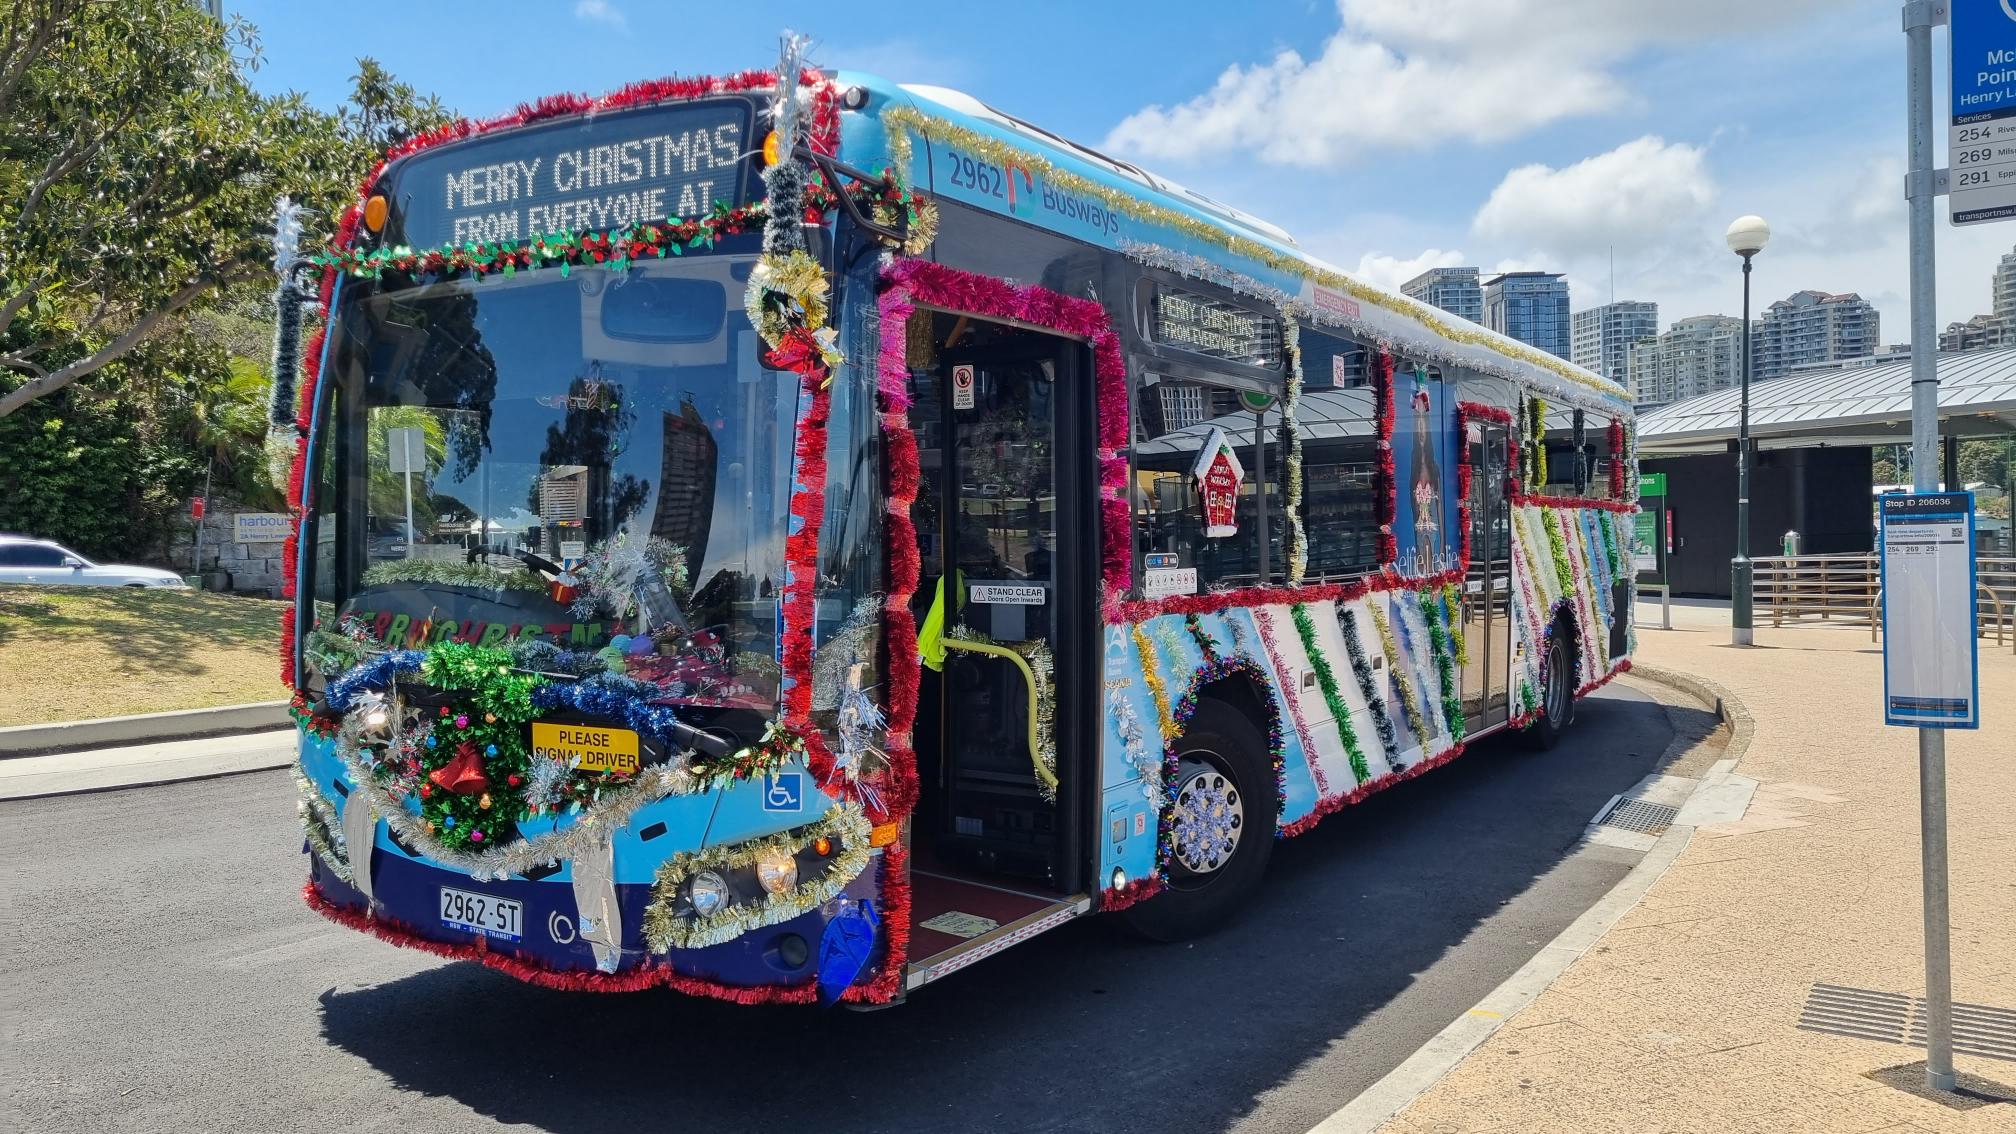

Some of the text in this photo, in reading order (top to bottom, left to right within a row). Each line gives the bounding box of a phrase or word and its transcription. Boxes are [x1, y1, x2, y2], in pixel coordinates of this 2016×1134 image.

[1987, 50, 2016, 65] Mc
[1960, 88, 2016, 106] Henry L
[1958, 113, 1992, 124] Services
[1959, 127, 1991, 142] 254
[1959, 149, 1992, 164] 269
[446, 123, 740, 209] MERRY CHRISTMAS
[948, 152, 1004, 198] 2962
[1959, 171, 1991, 186] 291
[454, 181, 714, 247] FROM EVERYONE AT
[1042, 181, 1120, 237] Busways
[1160, 293, 1255, 338] MERRY CHRISTMAS
[1164, 320, 1249, 356] FROM EVERYONE AT
[1885, 498, 1951, 508] Stop ID 206036
[987, 587, 1043, 596] STAND CLEAR
[1020, 596, 1043, 604] Inwards
[559, 730, 610, 747] PLEASE
[586, 751, 637, 767] DRIVER
[449, 922, 461, 930] NSW
[469, 926, 486, 936] STATE
[488, 930, 513, 940] TRANSIT
